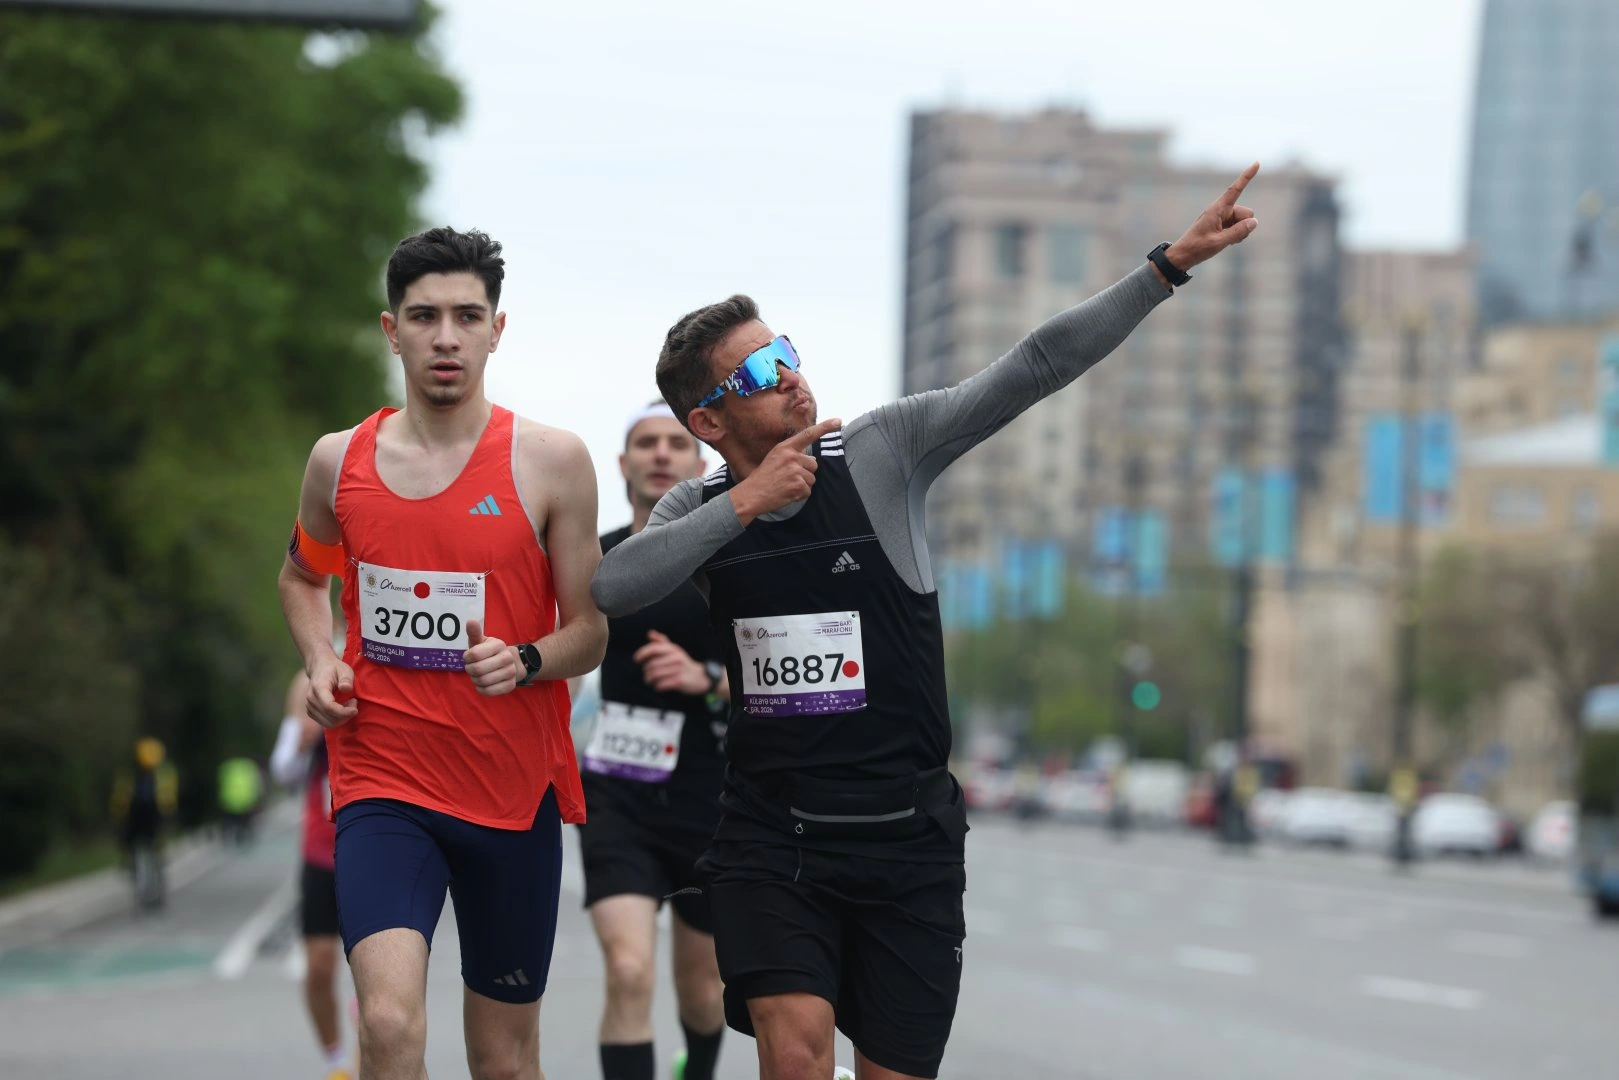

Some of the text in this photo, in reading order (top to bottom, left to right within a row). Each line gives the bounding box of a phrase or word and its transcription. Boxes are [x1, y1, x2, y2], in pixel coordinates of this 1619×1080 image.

[831, 563, 861, 573] adias
[445, 587, 478, 595] MARAFONU
[374, 606, 461, 641] 3700
[377, 654, 391, 663] 2026
[752, 653, 845, 687] 16887
[602, 733, 662, 760] 11239
